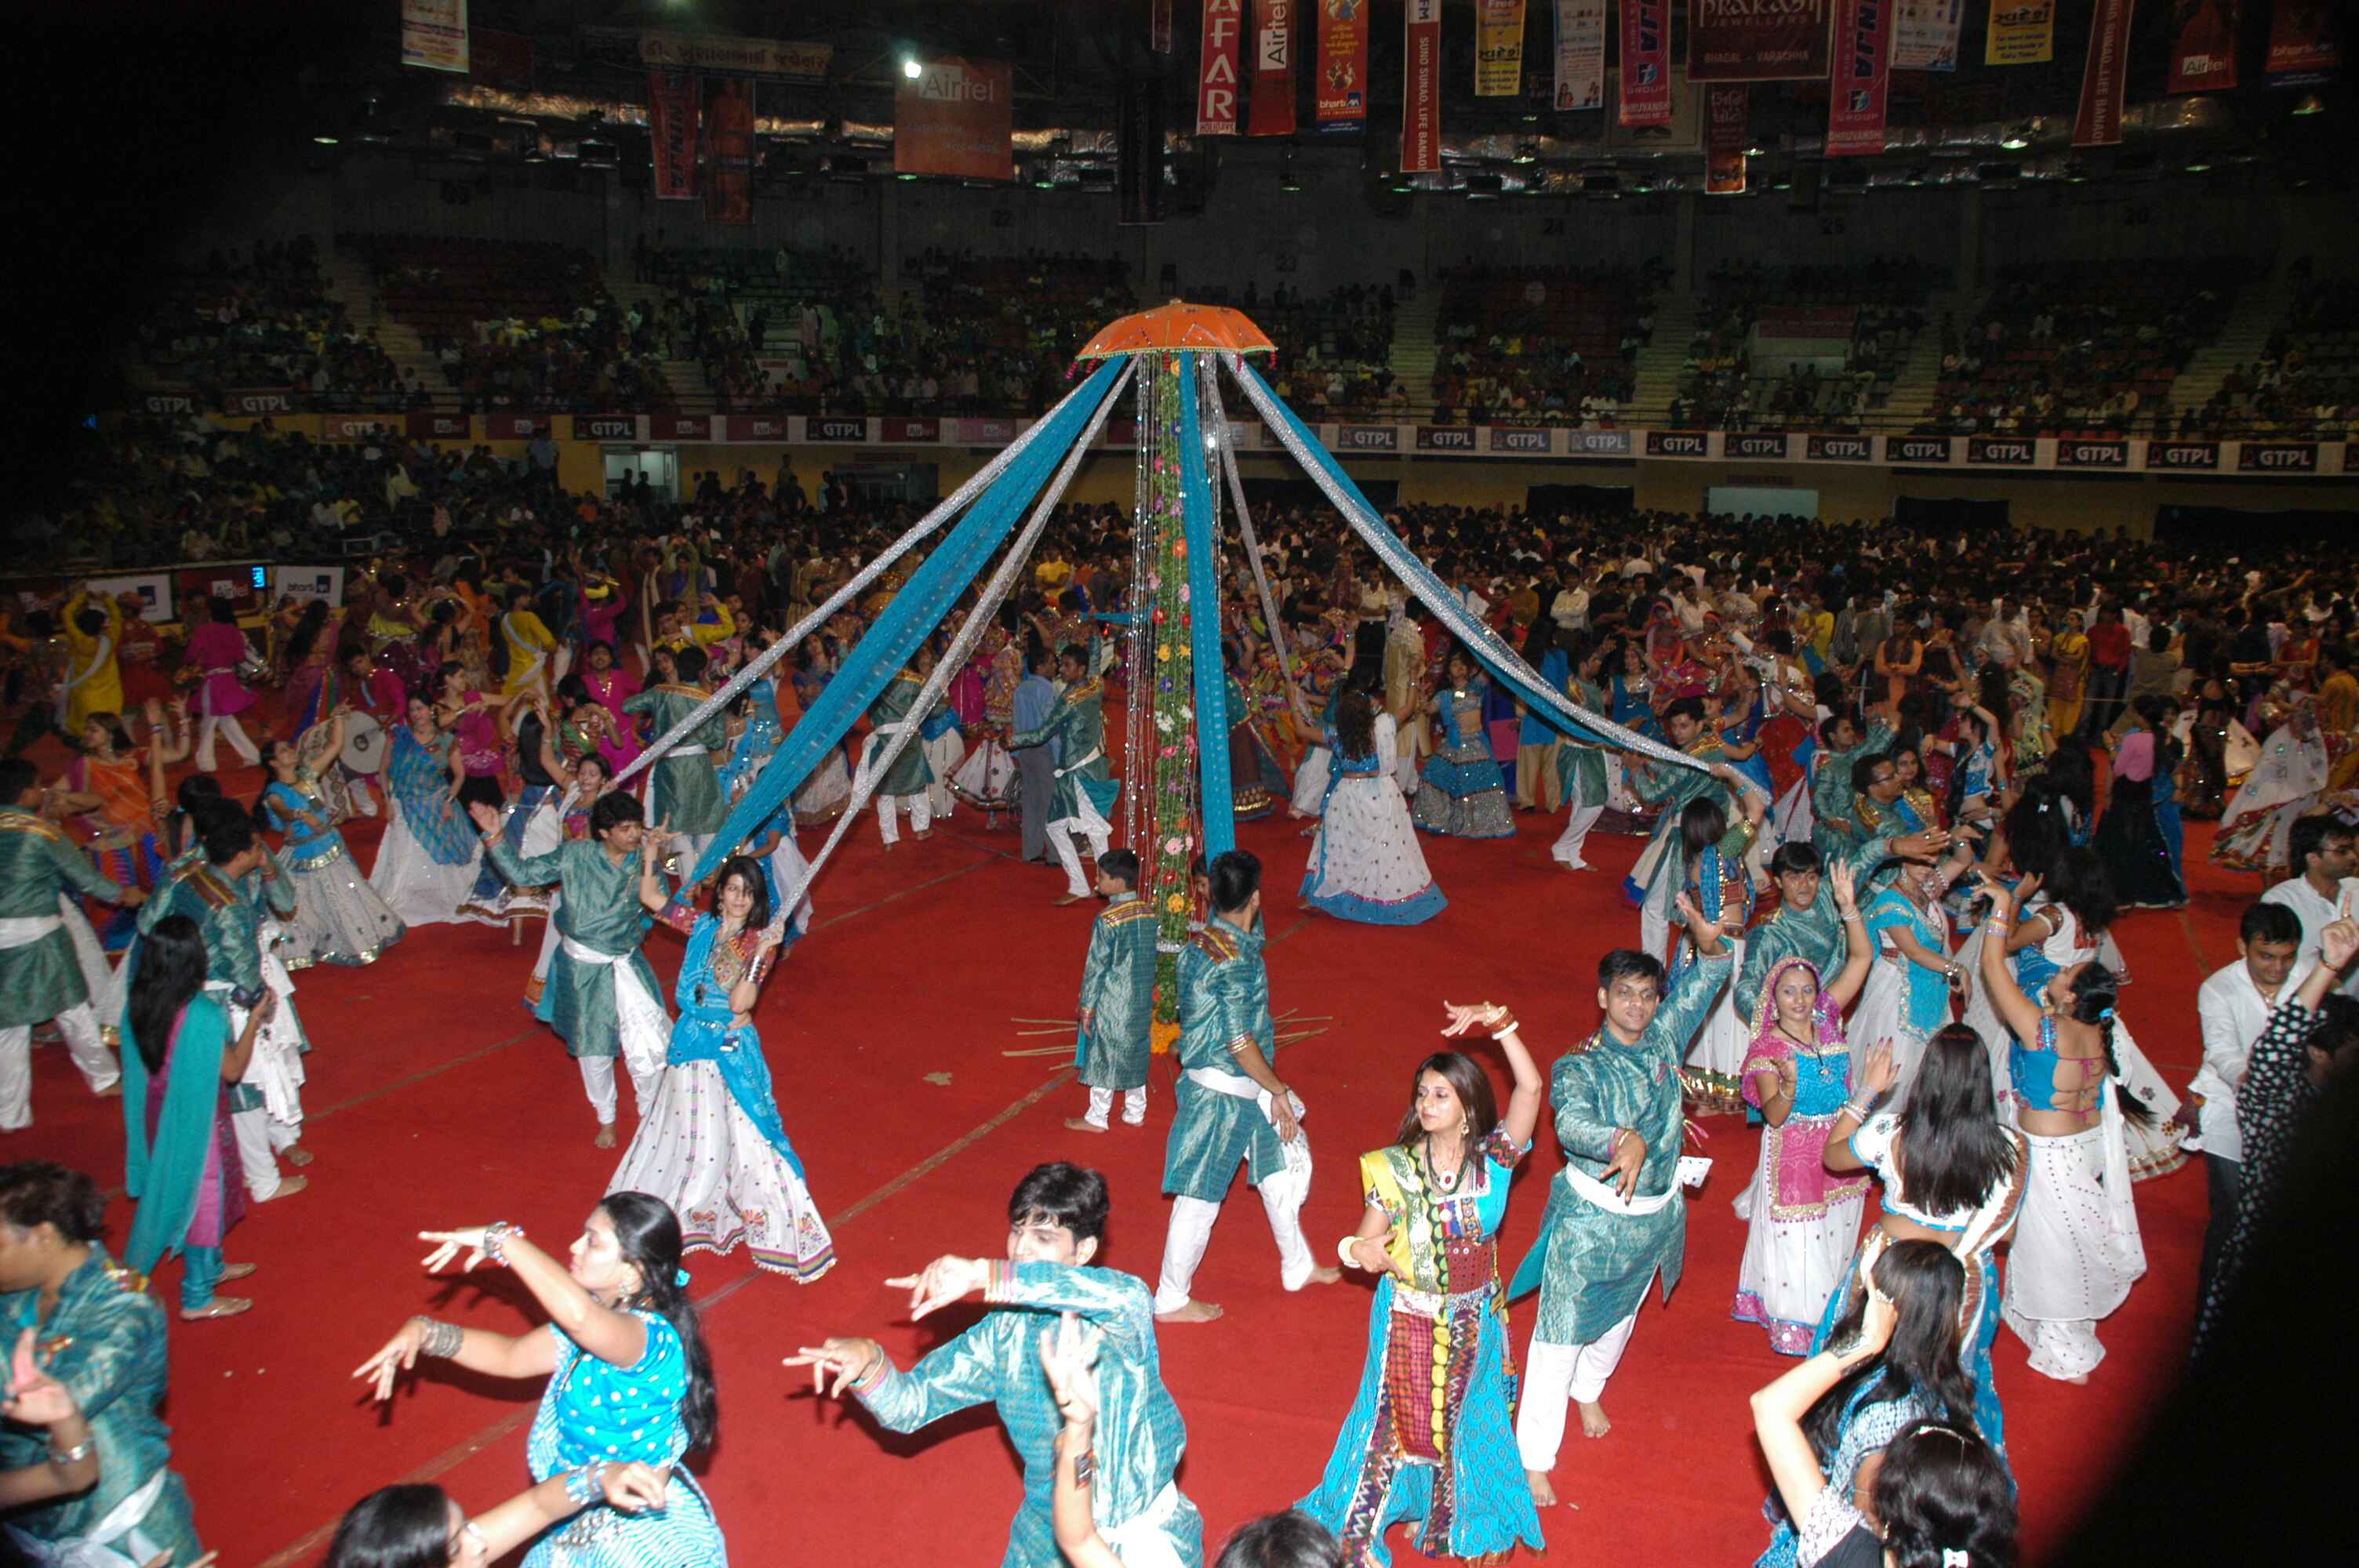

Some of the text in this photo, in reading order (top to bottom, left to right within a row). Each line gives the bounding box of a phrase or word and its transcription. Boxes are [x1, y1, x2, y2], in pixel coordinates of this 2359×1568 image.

[2184, 56, 2227, 73] Airtel
[922, 74, 994, 101] Airtel
[1418, 107, 1428, 129] LIFE
[242, 395, 291, 412] GTPL
[591, 421, 633, 437] GTPL
[822, 423, 863, 437] GTPL
[1354, 430, 1393, 445] GTPL
[1432, 431, 1472, 446] GTPL
[1506, 432, 1546, 448] GTPL
[1585, 433, 1626, 448] GTPL
[1663, 437, 1703, 452] GTPL
[1741, 439, 1782, 454] GTPL
[1824, 441, 1866, 456] GTPL
[1902, 443, 1945, 459] GTPL
[1985, 445, 2030, 460] GTPL
[2076, 445, 2121, 463] GTPL
[2165, 446, 2212, 464] GTPL
[2259, 448, 2310, 466] GTPL
